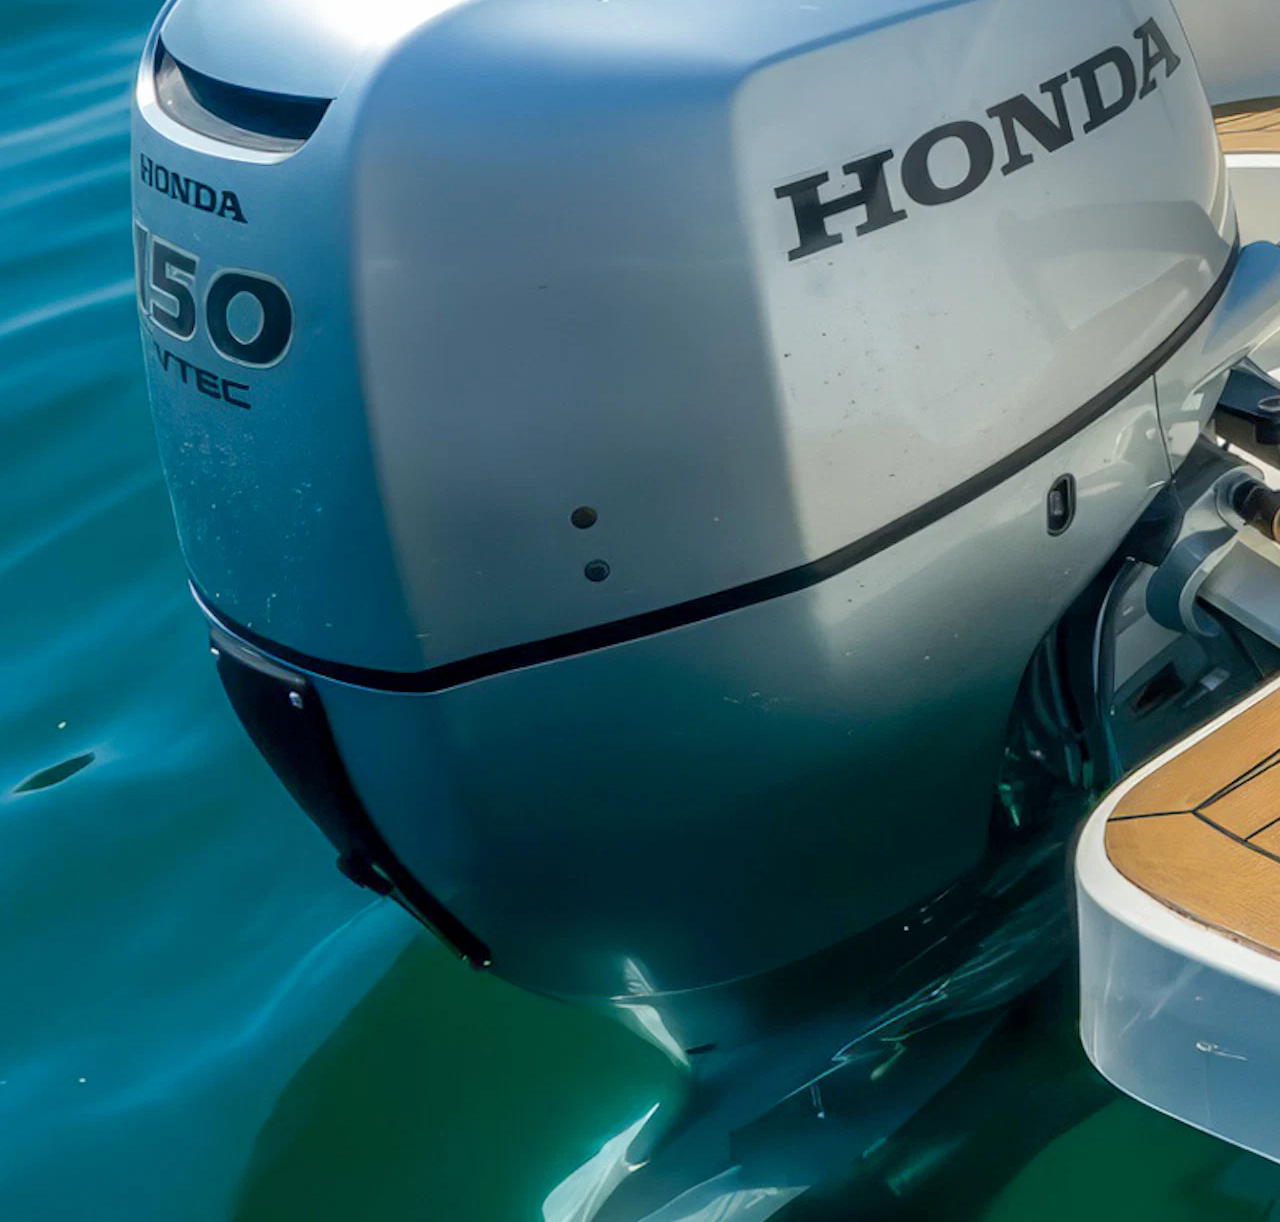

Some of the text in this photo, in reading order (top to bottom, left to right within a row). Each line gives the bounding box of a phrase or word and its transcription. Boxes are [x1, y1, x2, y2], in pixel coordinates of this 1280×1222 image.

[774, 17, 1181, 262] HONDA
[140, 153, 248, 224] HONDA
[154, 341, 252, 410] VTEC
